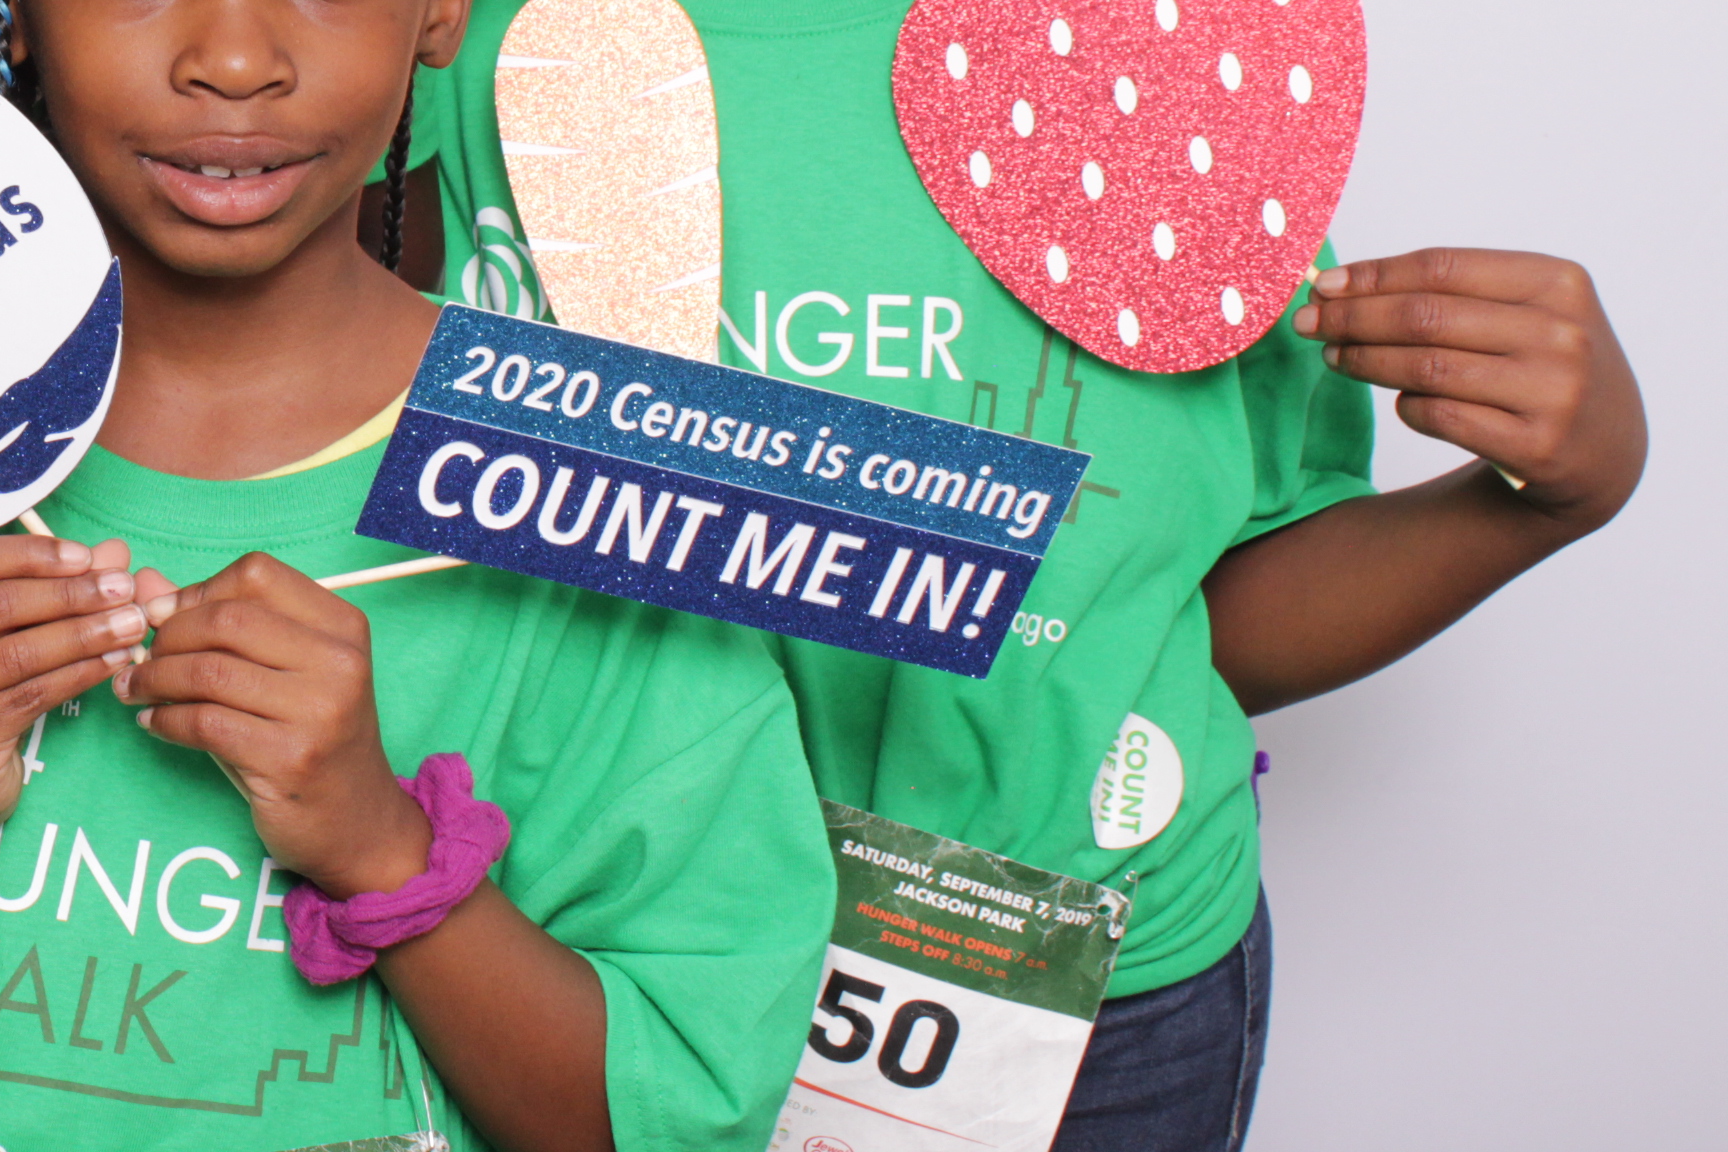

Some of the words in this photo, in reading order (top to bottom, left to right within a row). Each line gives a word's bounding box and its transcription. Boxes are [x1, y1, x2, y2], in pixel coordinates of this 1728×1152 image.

[718, 290, 964, 381] NGER
[453, 345, 601, 419] 2020
[609, 382, 798, 467] Census
[802, 426, 853, 480] is
[858, 452, 1053, 539] coming
[418, 440, 725, 573] COUNT
[719, 511, 867, 608] ME
[867, 546, 1007, 640] IN!
[1012, 611, 1068, 647] ago
[1118, 729, 1150, 835] COUNT
[840, 839, 936, 885] SATURDAY,
[939, 871, 1035, 913] SEPTEMBER
[1034, 900, 1051, 920] 7,
[1053, 906, 1094, 927] 2019
[893, 881, 977, 921] JACKSON
[977, 906, 1027, 934] PARK
[856, 901, 919, 934] HUNGER
[919, 922, 963, 947] WALK
[964, 937, 1013, 962] OPENS
[1014, 950, 1026, 964] 7
[879, 930, 921, 953] STEPS
[922, 943, 951, 962] OFF
[951, 952, 983, 973] 8:30
[984, 964, 1009, 981] a.m.
